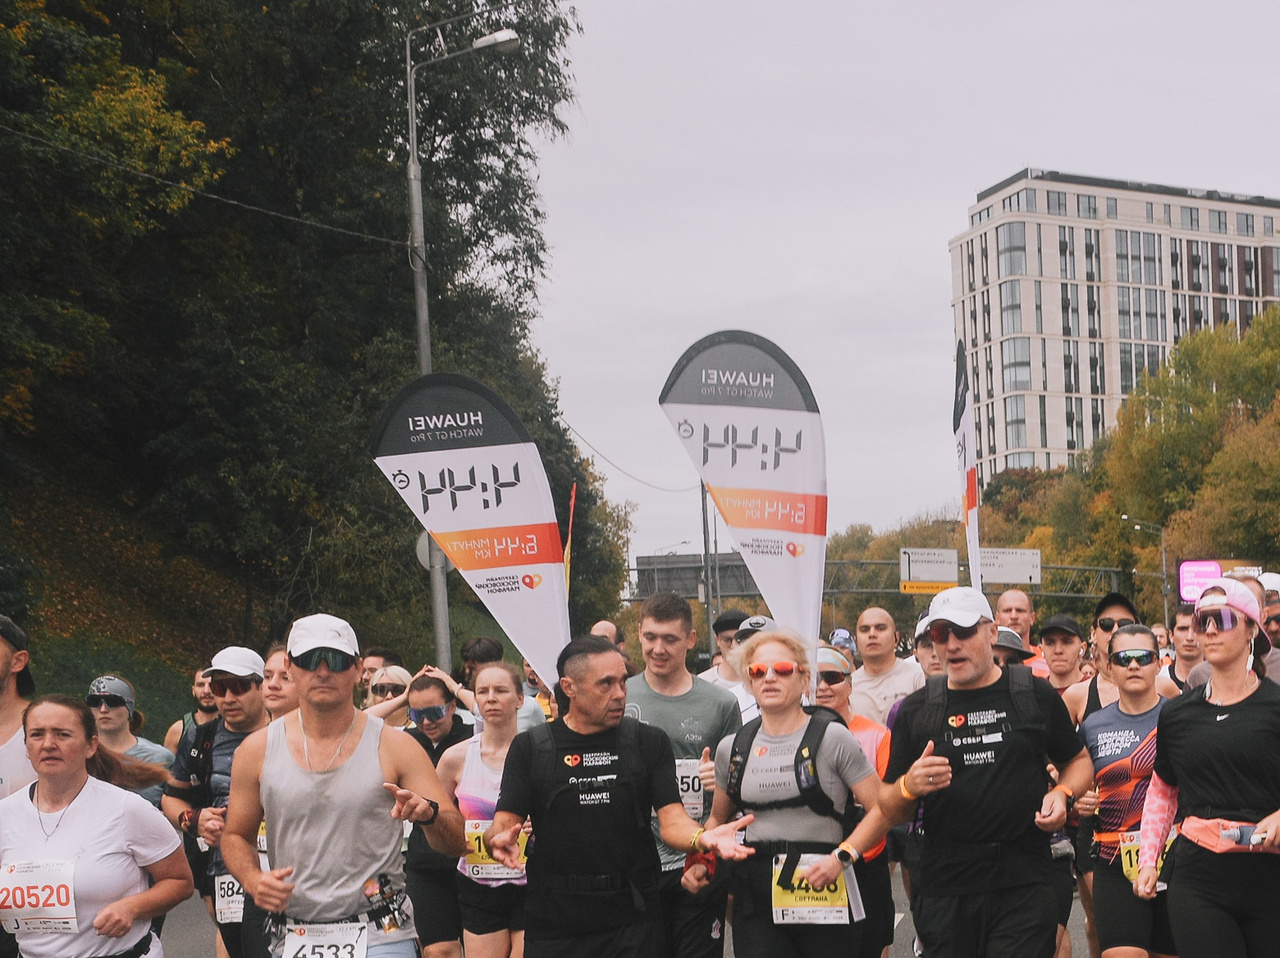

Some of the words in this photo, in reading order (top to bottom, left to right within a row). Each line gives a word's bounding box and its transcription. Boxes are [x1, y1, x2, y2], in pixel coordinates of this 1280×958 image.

[579, 792, 610, 801] HUAWEI
[471, 865, 480, 875] G
[0, 884, 70, 909] 20520
